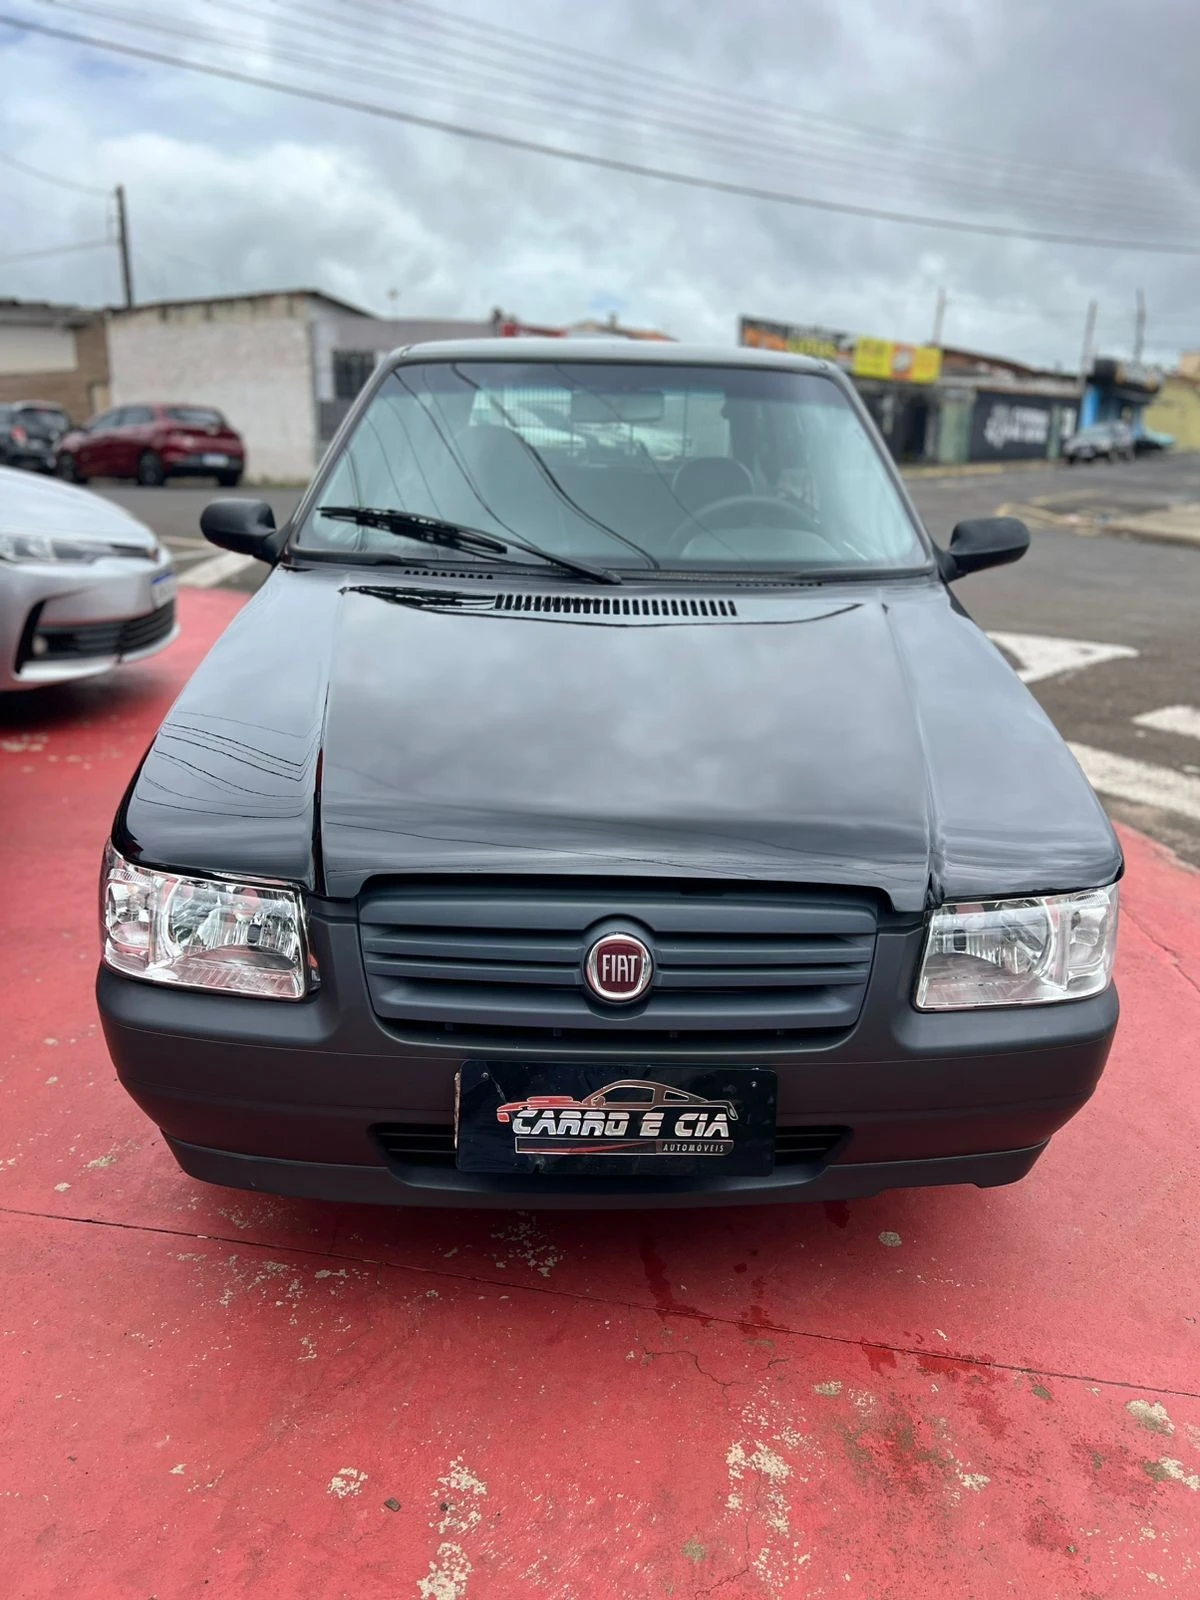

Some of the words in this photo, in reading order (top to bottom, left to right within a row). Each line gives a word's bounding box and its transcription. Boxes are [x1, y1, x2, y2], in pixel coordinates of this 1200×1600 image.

[602, 954, 638, 982] FIAT
[512, 1110, 630, 1136] CARRO
[639, 1112, 665, 1136] E
[674, 1113, 729, 1137] CIA
[662, 1143, 724, 1152] AUTOMÓVEIS
